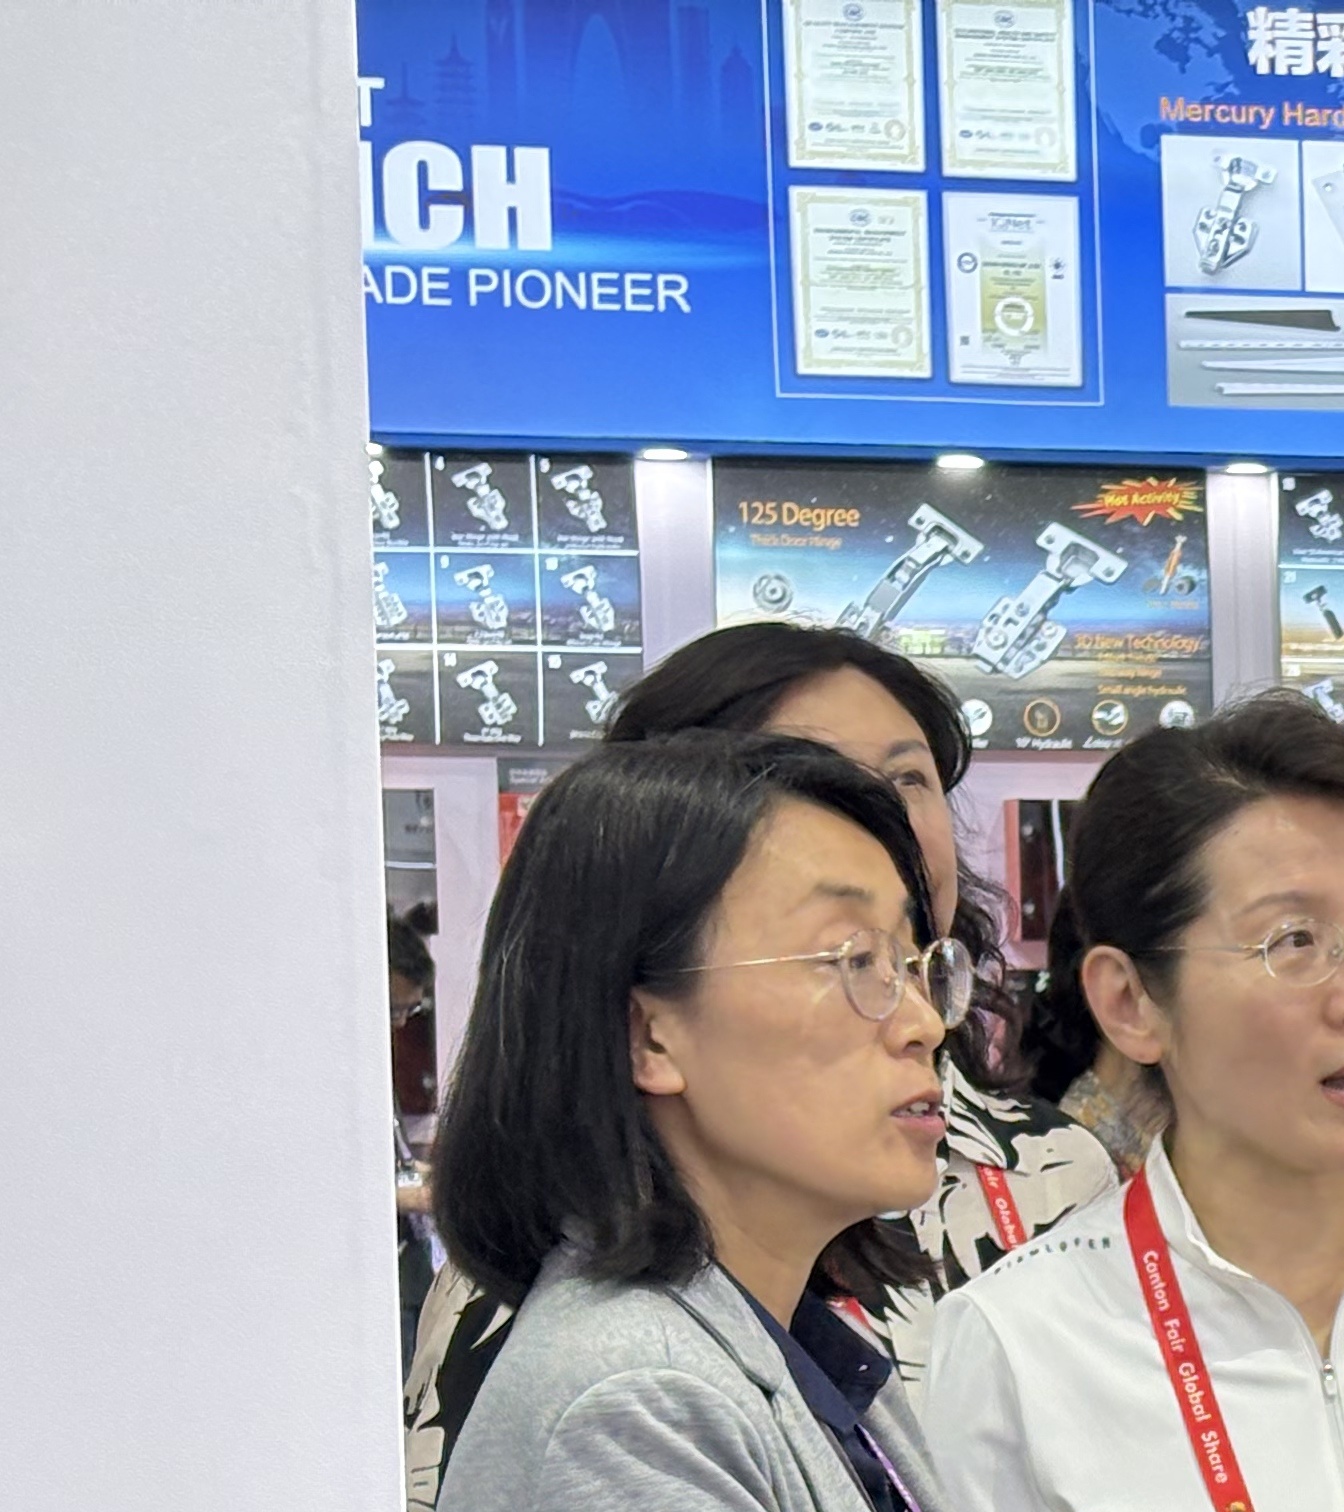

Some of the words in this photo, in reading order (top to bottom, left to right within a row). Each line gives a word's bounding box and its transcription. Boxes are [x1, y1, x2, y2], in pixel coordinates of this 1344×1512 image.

[357, 76, 385, 127] T
[1160, 96, 1275, 130] Mercury
[362, 265, 452, 305] ADE
[469, 267, 691, 313] PIONEER
[738, 501, 779, 525] 125
[781, 501, 861, 532] Degree
[1142, 1249, 1171, 1313] Canton
[1163, 1318, 1186, 1354] Fair
[1178, 1363, 1212, 1424] Global
[1201, 1430, 1229, 1486] Share
